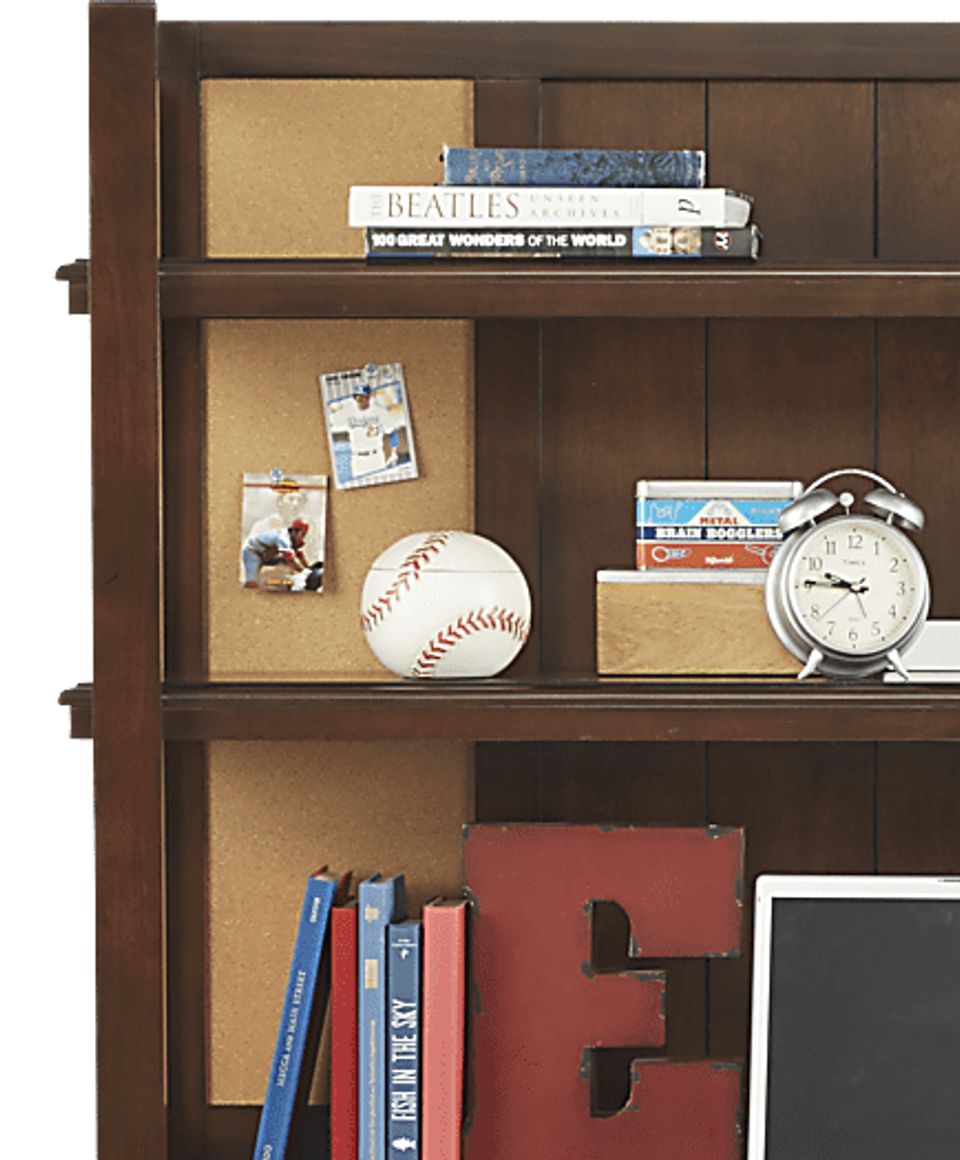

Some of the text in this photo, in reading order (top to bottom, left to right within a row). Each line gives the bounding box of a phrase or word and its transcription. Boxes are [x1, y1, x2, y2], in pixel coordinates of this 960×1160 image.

[387, 191, 520, 219] BEATLES
[530, 208, 620, 219] ARCHIVES
[371, 233, 627, 247] 100 GREAT WONDERS OF THE WORLD
[700, 517, 739, 525] METAL
[655, 527, 784, 540] BRAIN BOGGLERS
[826, 540, 837, 556] 11
[848, 534, 864, 550] 12
[873, 541, 880, 556] 1
[808, 556, 823, 571] 10
[889, 556, 899, 573] 2
[896, 582, 906, 596] 3
[810, 603, 821, 620] 8
[888, 604, 897, 619] 4
[826, 621, 837, 636] 7
[848, 628, 859, 642] 6
[870, 621, 881, 637] 5
[391, 998, 417, 1122] FISH IN THE SKY
